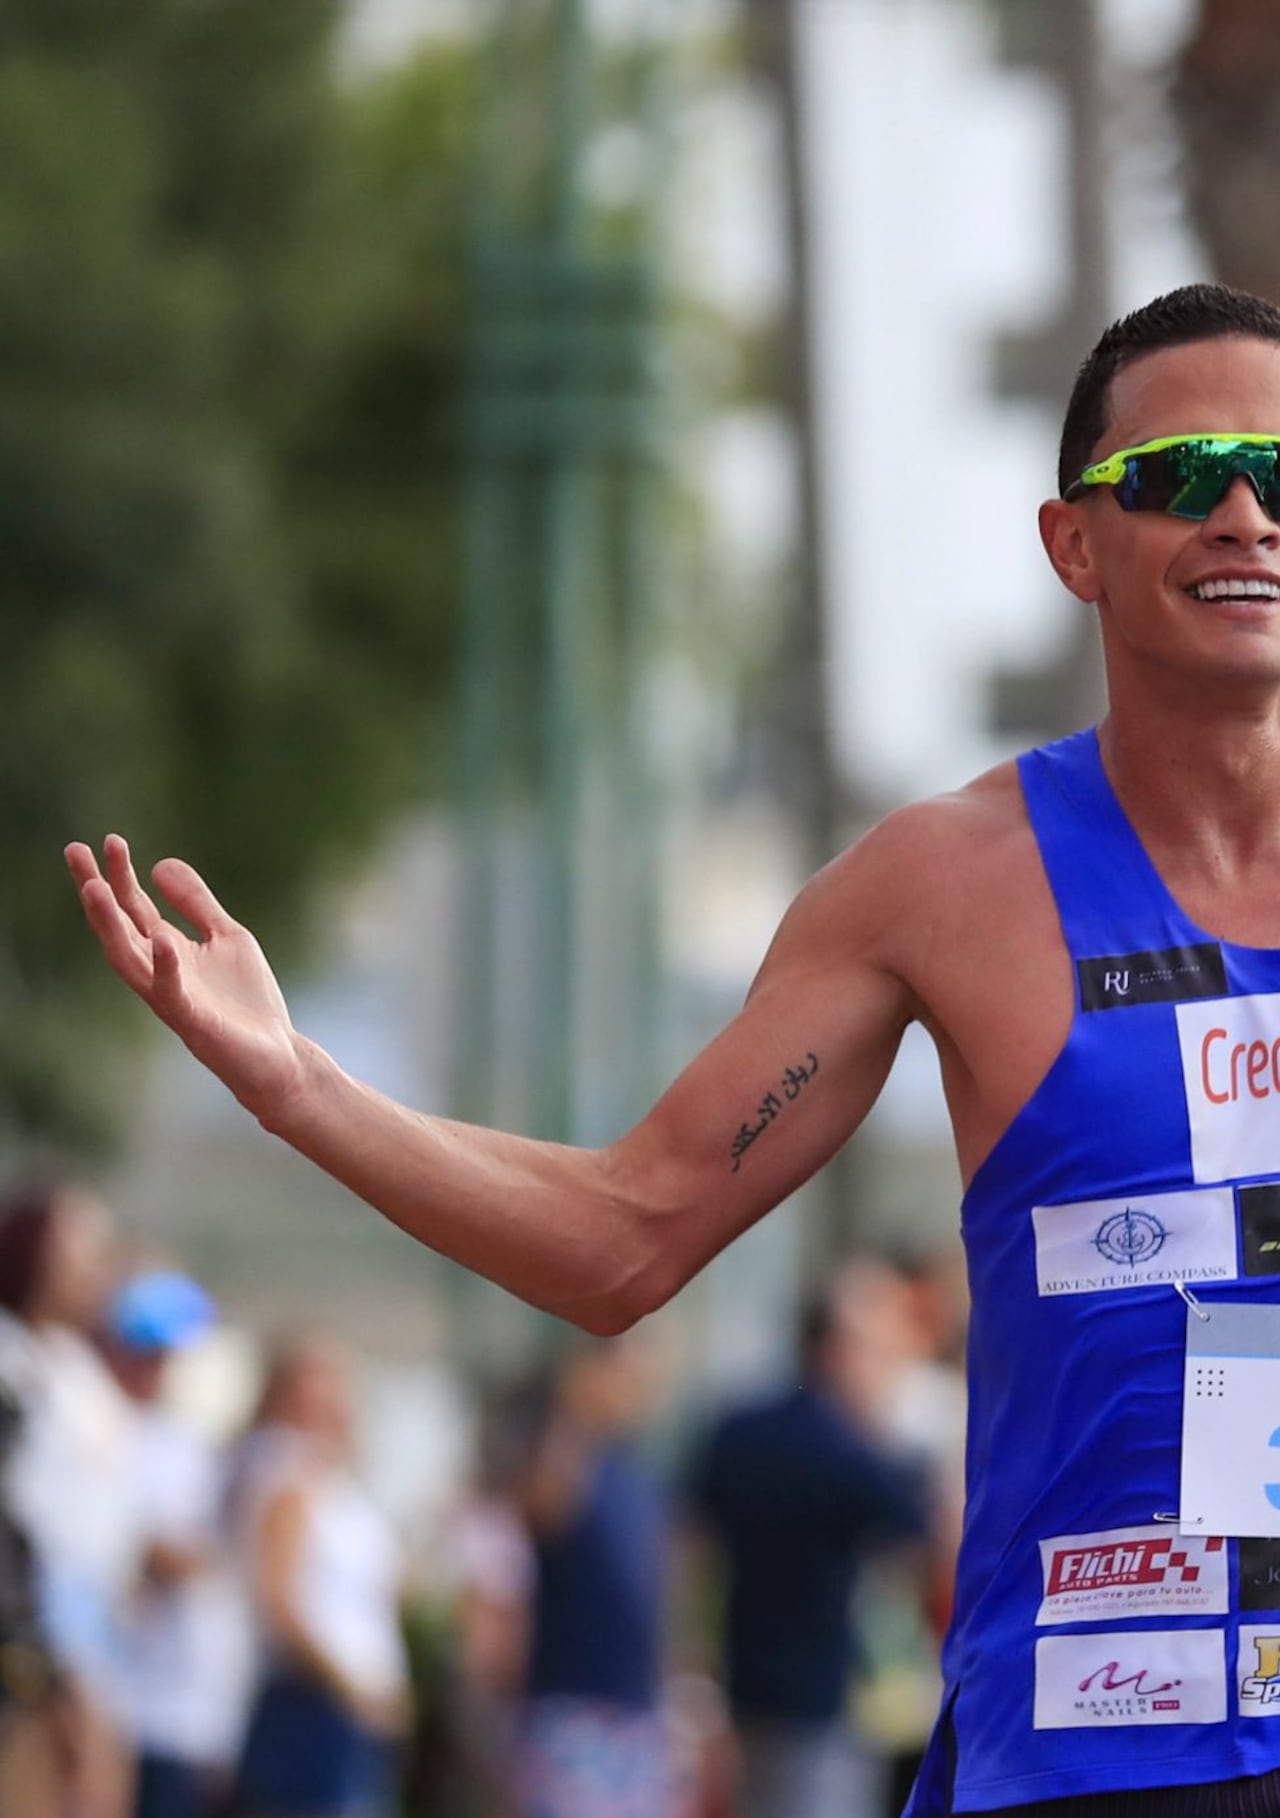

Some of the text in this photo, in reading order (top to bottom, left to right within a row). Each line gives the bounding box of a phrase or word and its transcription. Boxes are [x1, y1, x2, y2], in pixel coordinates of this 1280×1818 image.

[1043, 1265, 1228, 1293] ADVENTURE COMPASS
[1127, 1587, 1156, 1600] para
